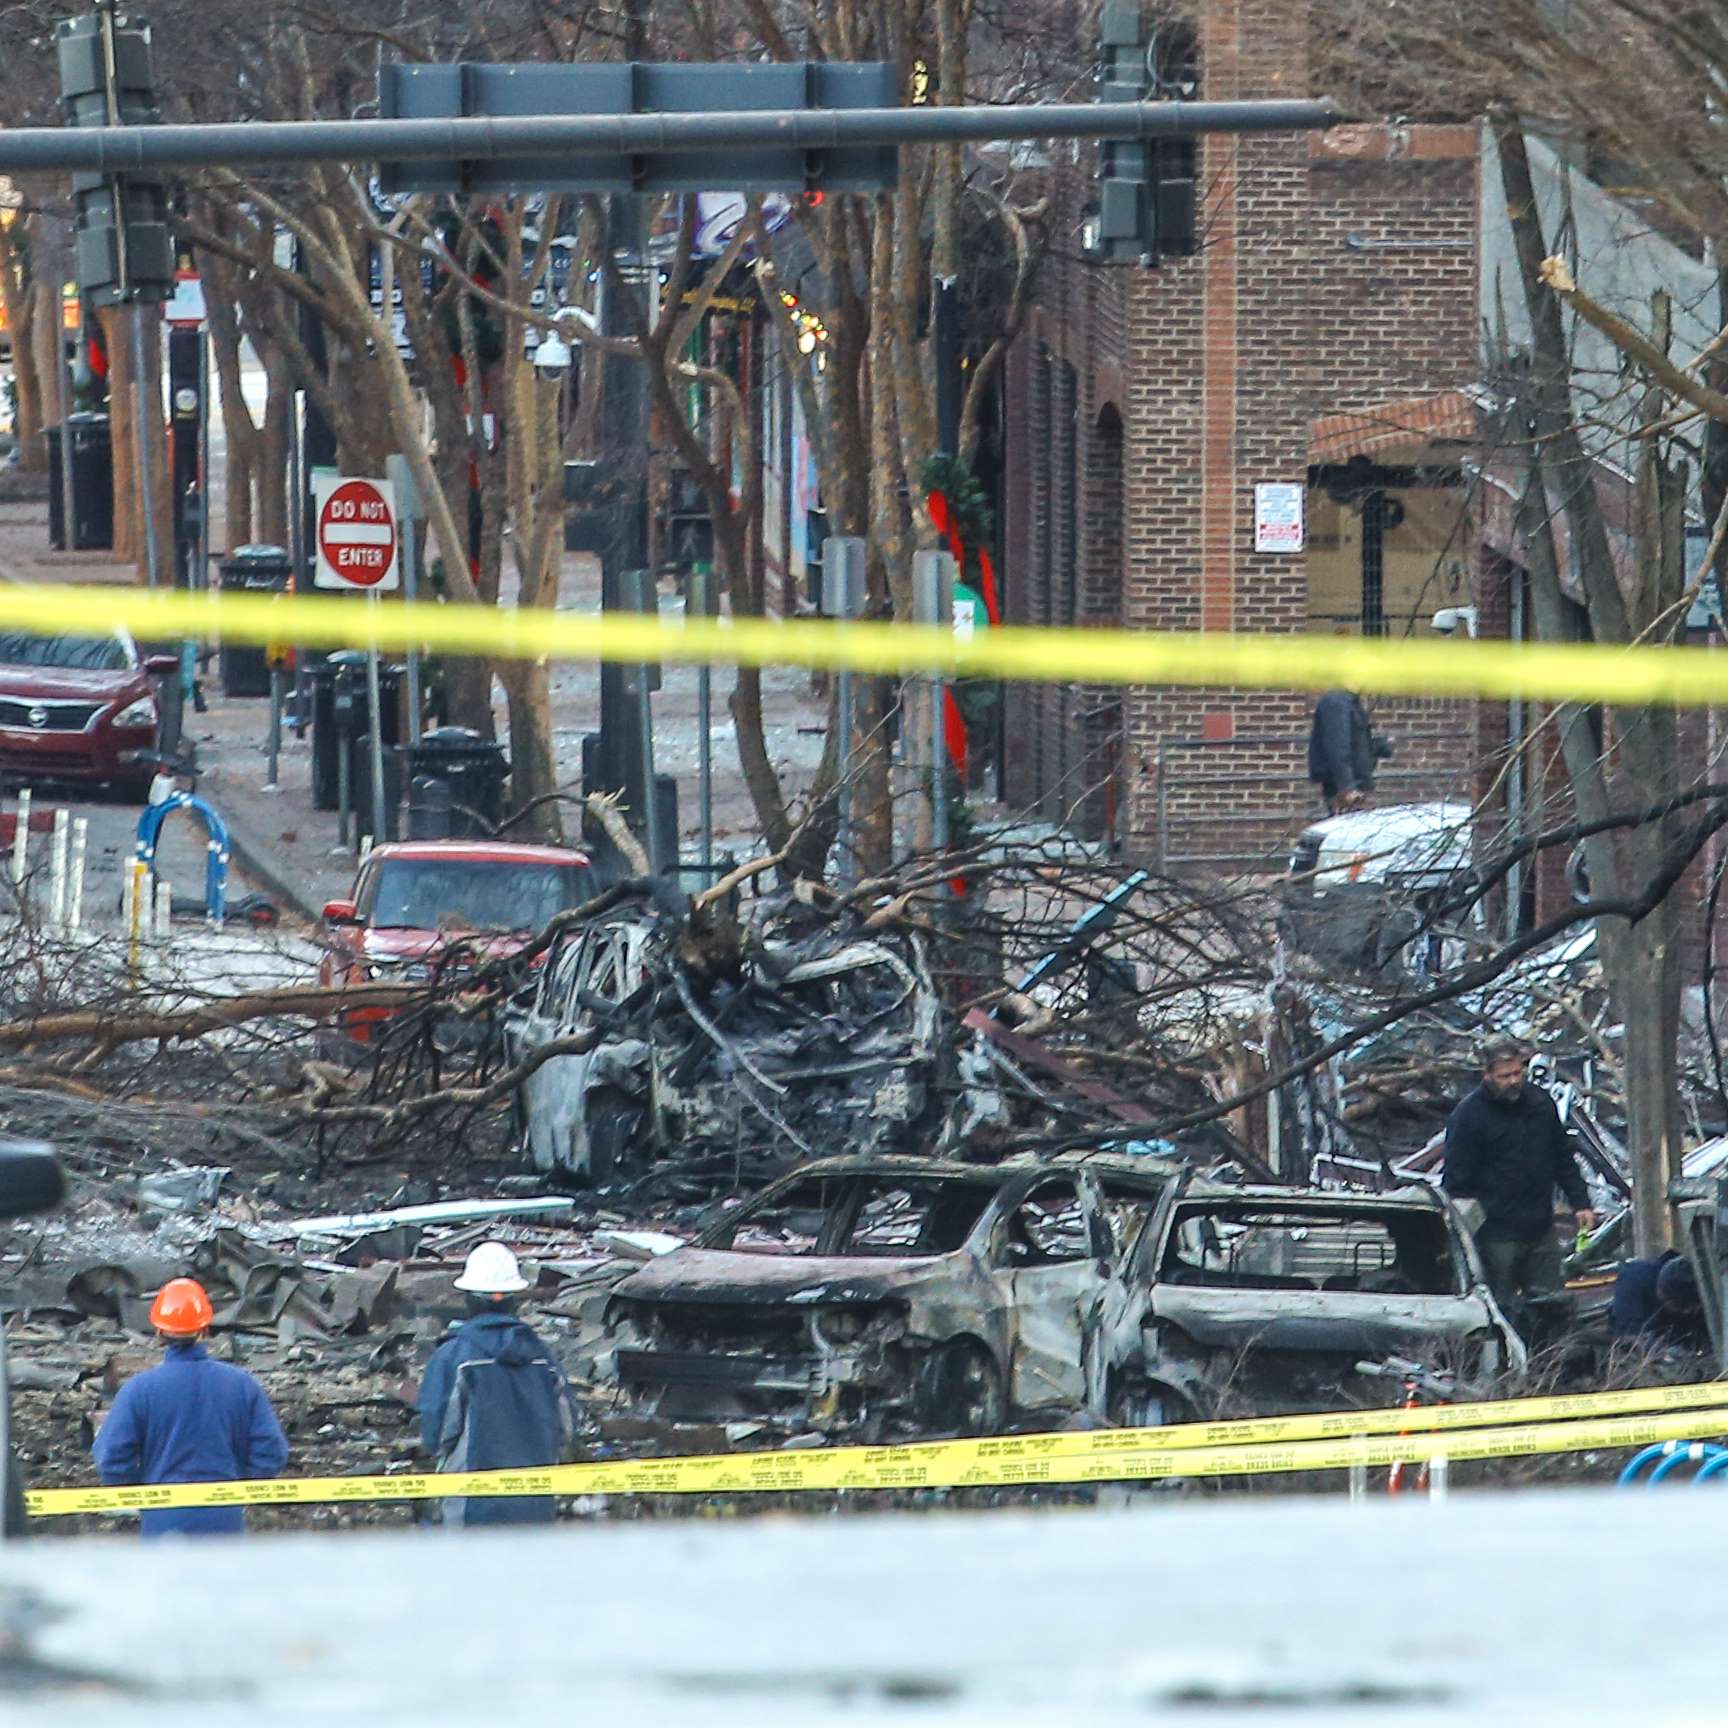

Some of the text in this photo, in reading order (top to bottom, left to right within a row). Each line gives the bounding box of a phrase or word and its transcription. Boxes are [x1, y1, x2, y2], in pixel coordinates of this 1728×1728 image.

[330, 499, 386, 520] DO NOT
[338, 547, 384, 567] ENTER
